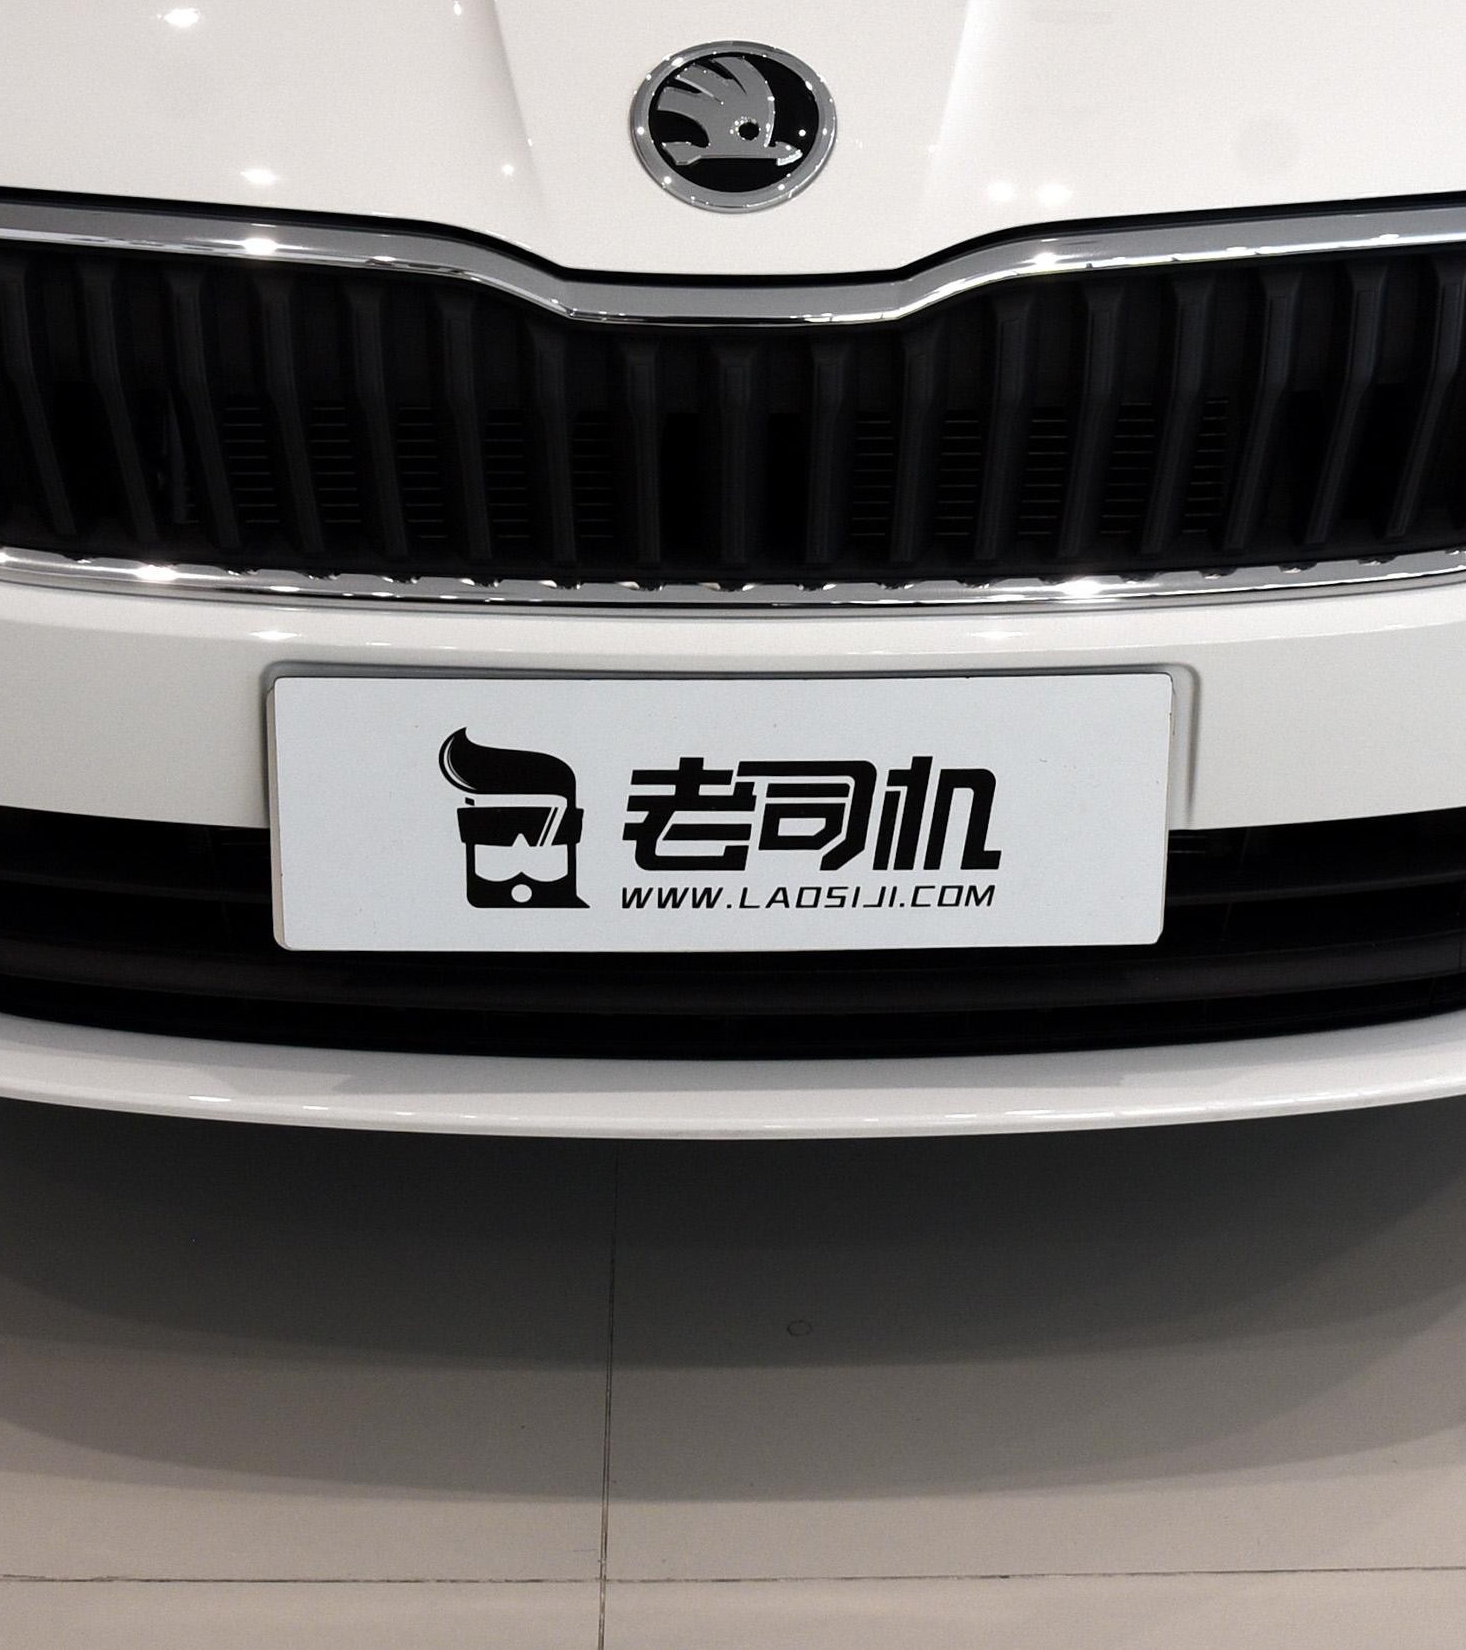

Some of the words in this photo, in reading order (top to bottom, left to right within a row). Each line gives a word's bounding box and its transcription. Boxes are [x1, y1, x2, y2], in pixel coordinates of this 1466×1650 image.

[622, 756, 1001, 871] 老司机
[621, 884, 996, 909] WWW.LAOSIJI.COM
